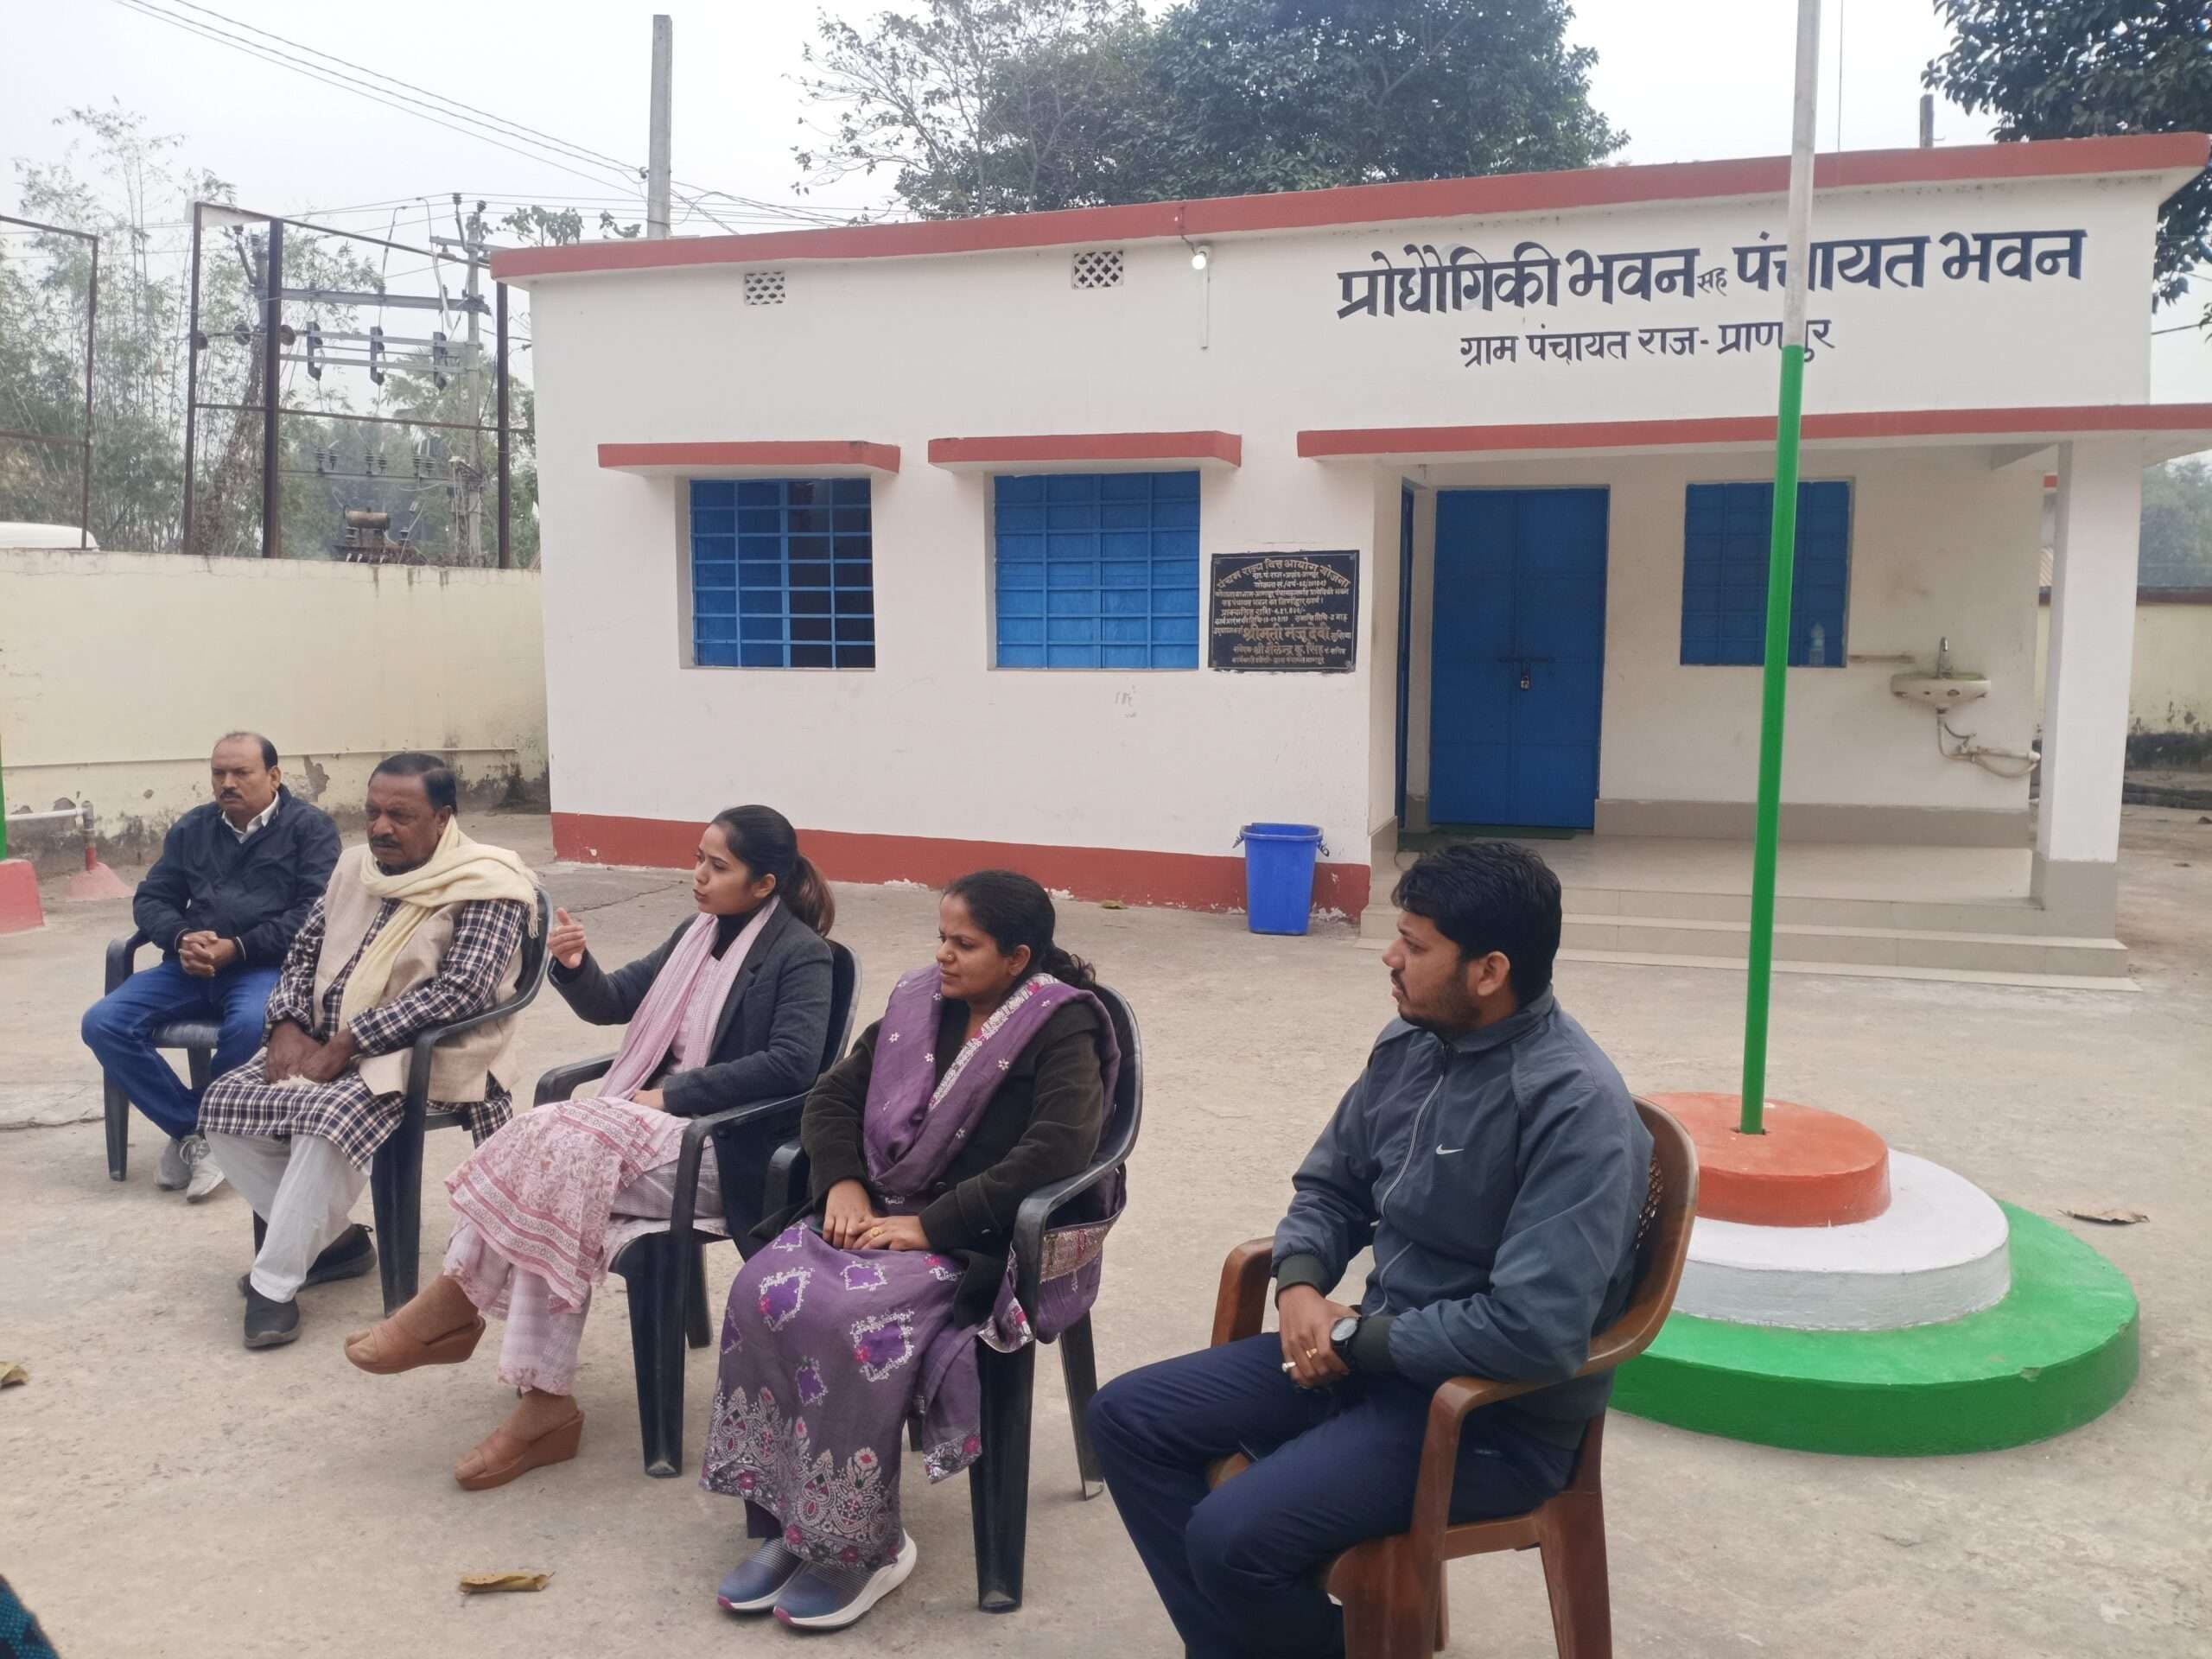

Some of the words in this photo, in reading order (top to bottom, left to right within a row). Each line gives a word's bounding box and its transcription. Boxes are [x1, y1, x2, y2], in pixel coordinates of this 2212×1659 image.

[1566, 247, 1701, 305] भवन
[1696, 266, 1729, 297] सह
[1939, 228, 2088, 284] भवन
[1460, 335, 1520, 368] ग्राम
[1524, 322, 1631, 368] पंचायत
[1243, 622, 1284, 642] श्रीमती
[1308, 621, 1332, 642] देवी
